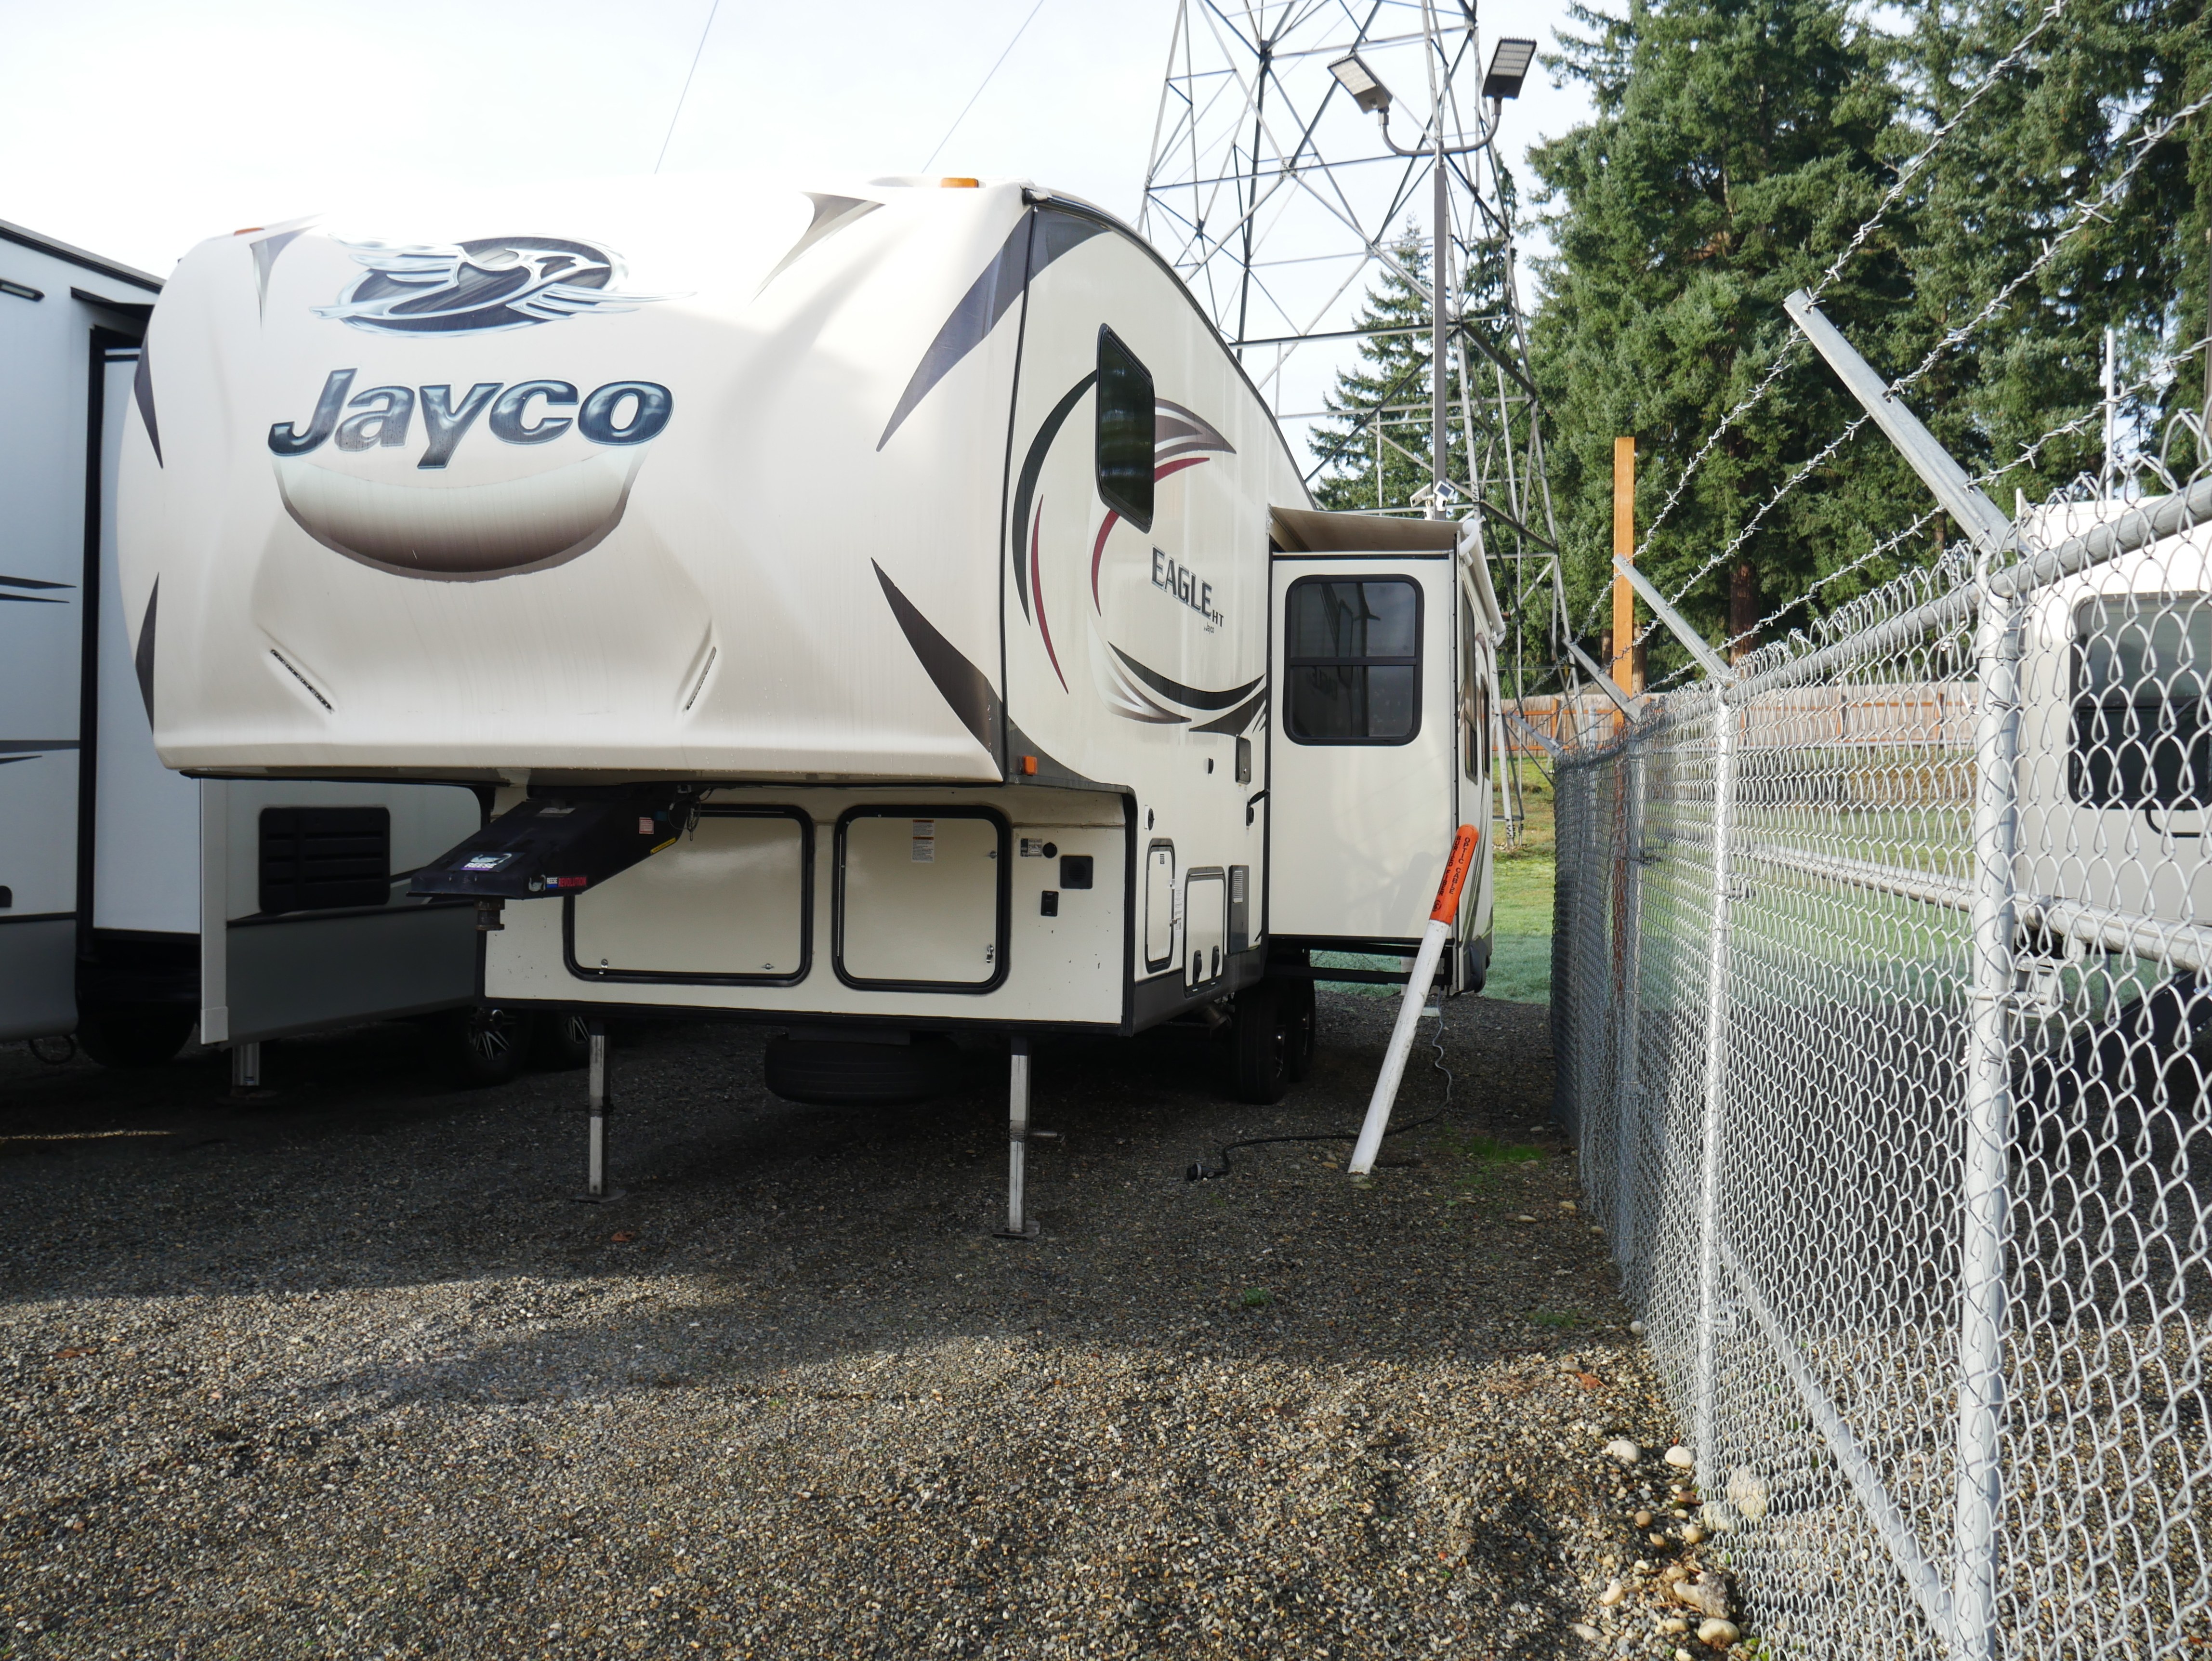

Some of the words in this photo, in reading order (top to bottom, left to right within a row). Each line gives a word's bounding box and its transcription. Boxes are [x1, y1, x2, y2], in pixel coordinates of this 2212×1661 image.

[268, 367, 674, 469] Jayco
[1151, 544, 1212, 620] EAGLE
[1212, 609, 1224, 628] HT
[1448, 835, 1461, 867] BURIED
[1458, 837, 1470, 864] OPTIC
[558, 876, 587, 887] REVOLUTION
[1439, 869, 1451, 896] FIBER
[1449, 868, 1462, 895] CABLE
